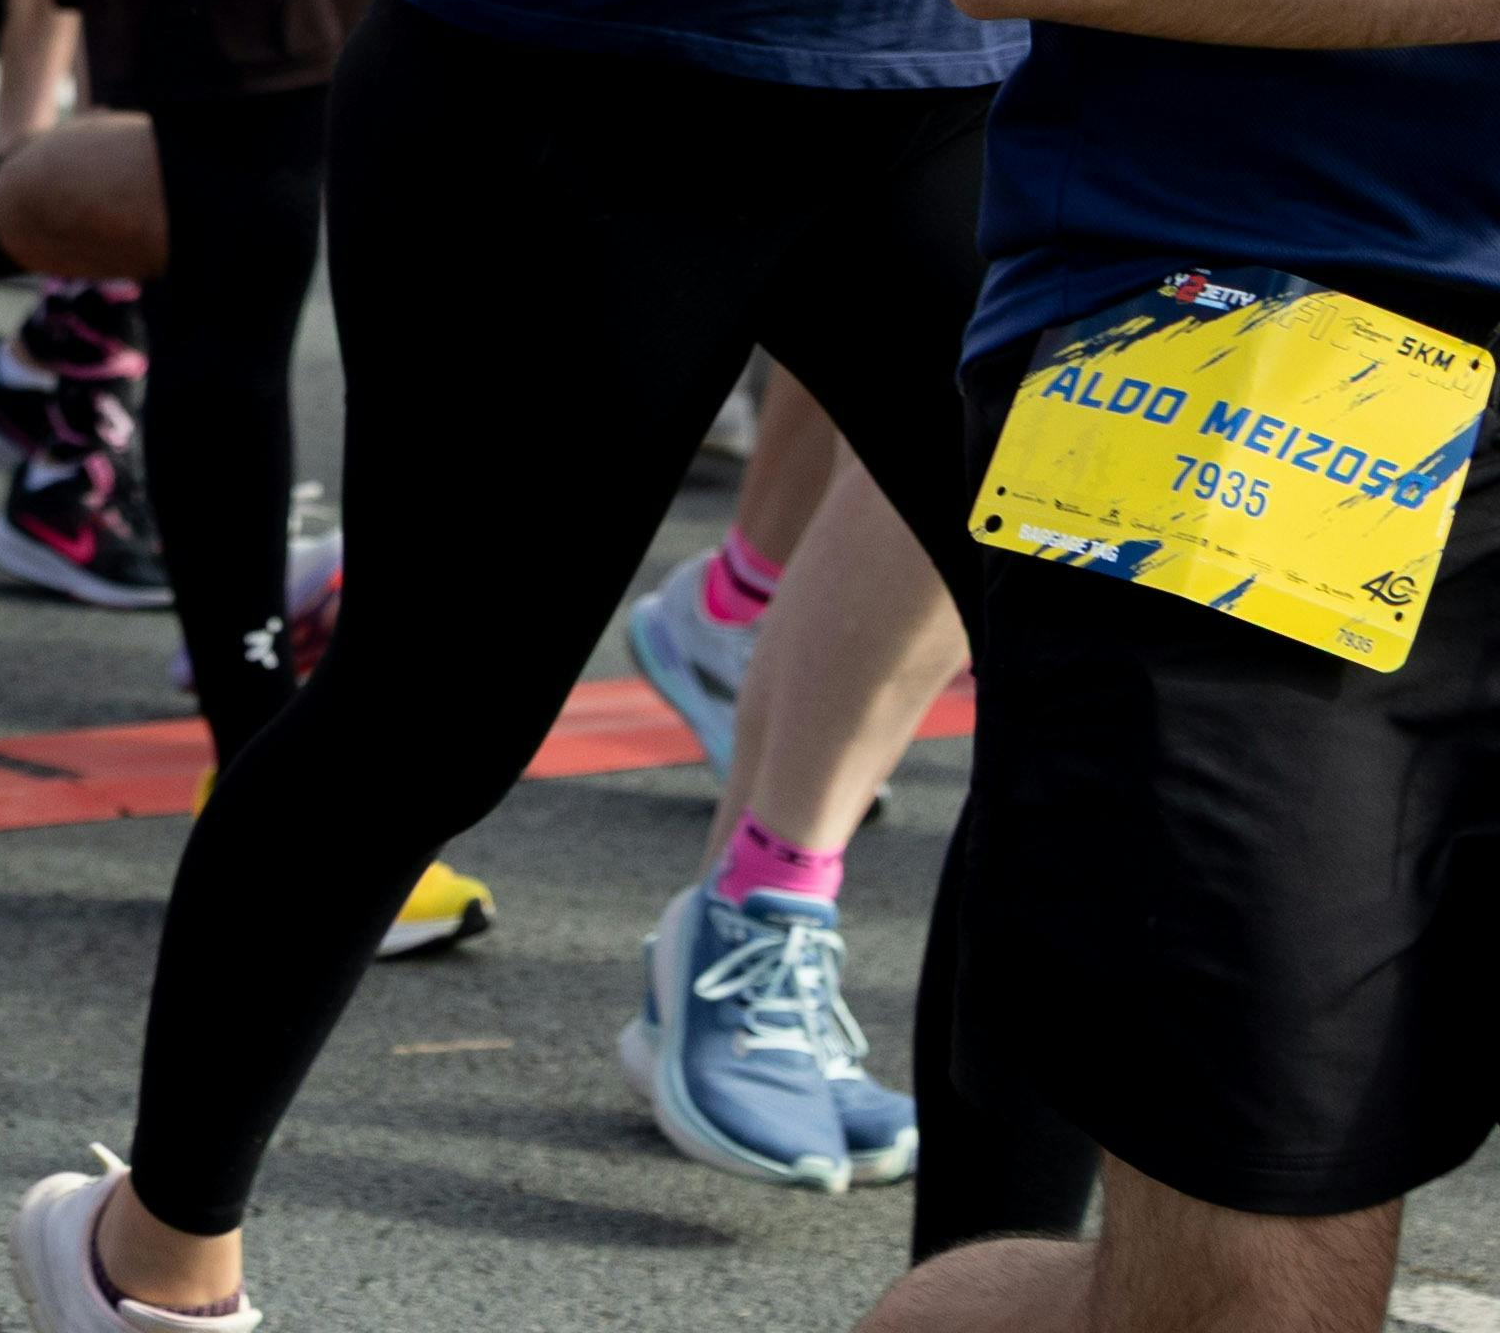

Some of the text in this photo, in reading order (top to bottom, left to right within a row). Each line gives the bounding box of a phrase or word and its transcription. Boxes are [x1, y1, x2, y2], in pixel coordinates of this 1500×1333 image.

[1396, 336, 1454, 371] 5KM
[1042, 365, 1439, 510] ALDO MEIZOSO
[1170, 454, 1271, 518] 7935
[1334, 627, 1374, 655] 7935
